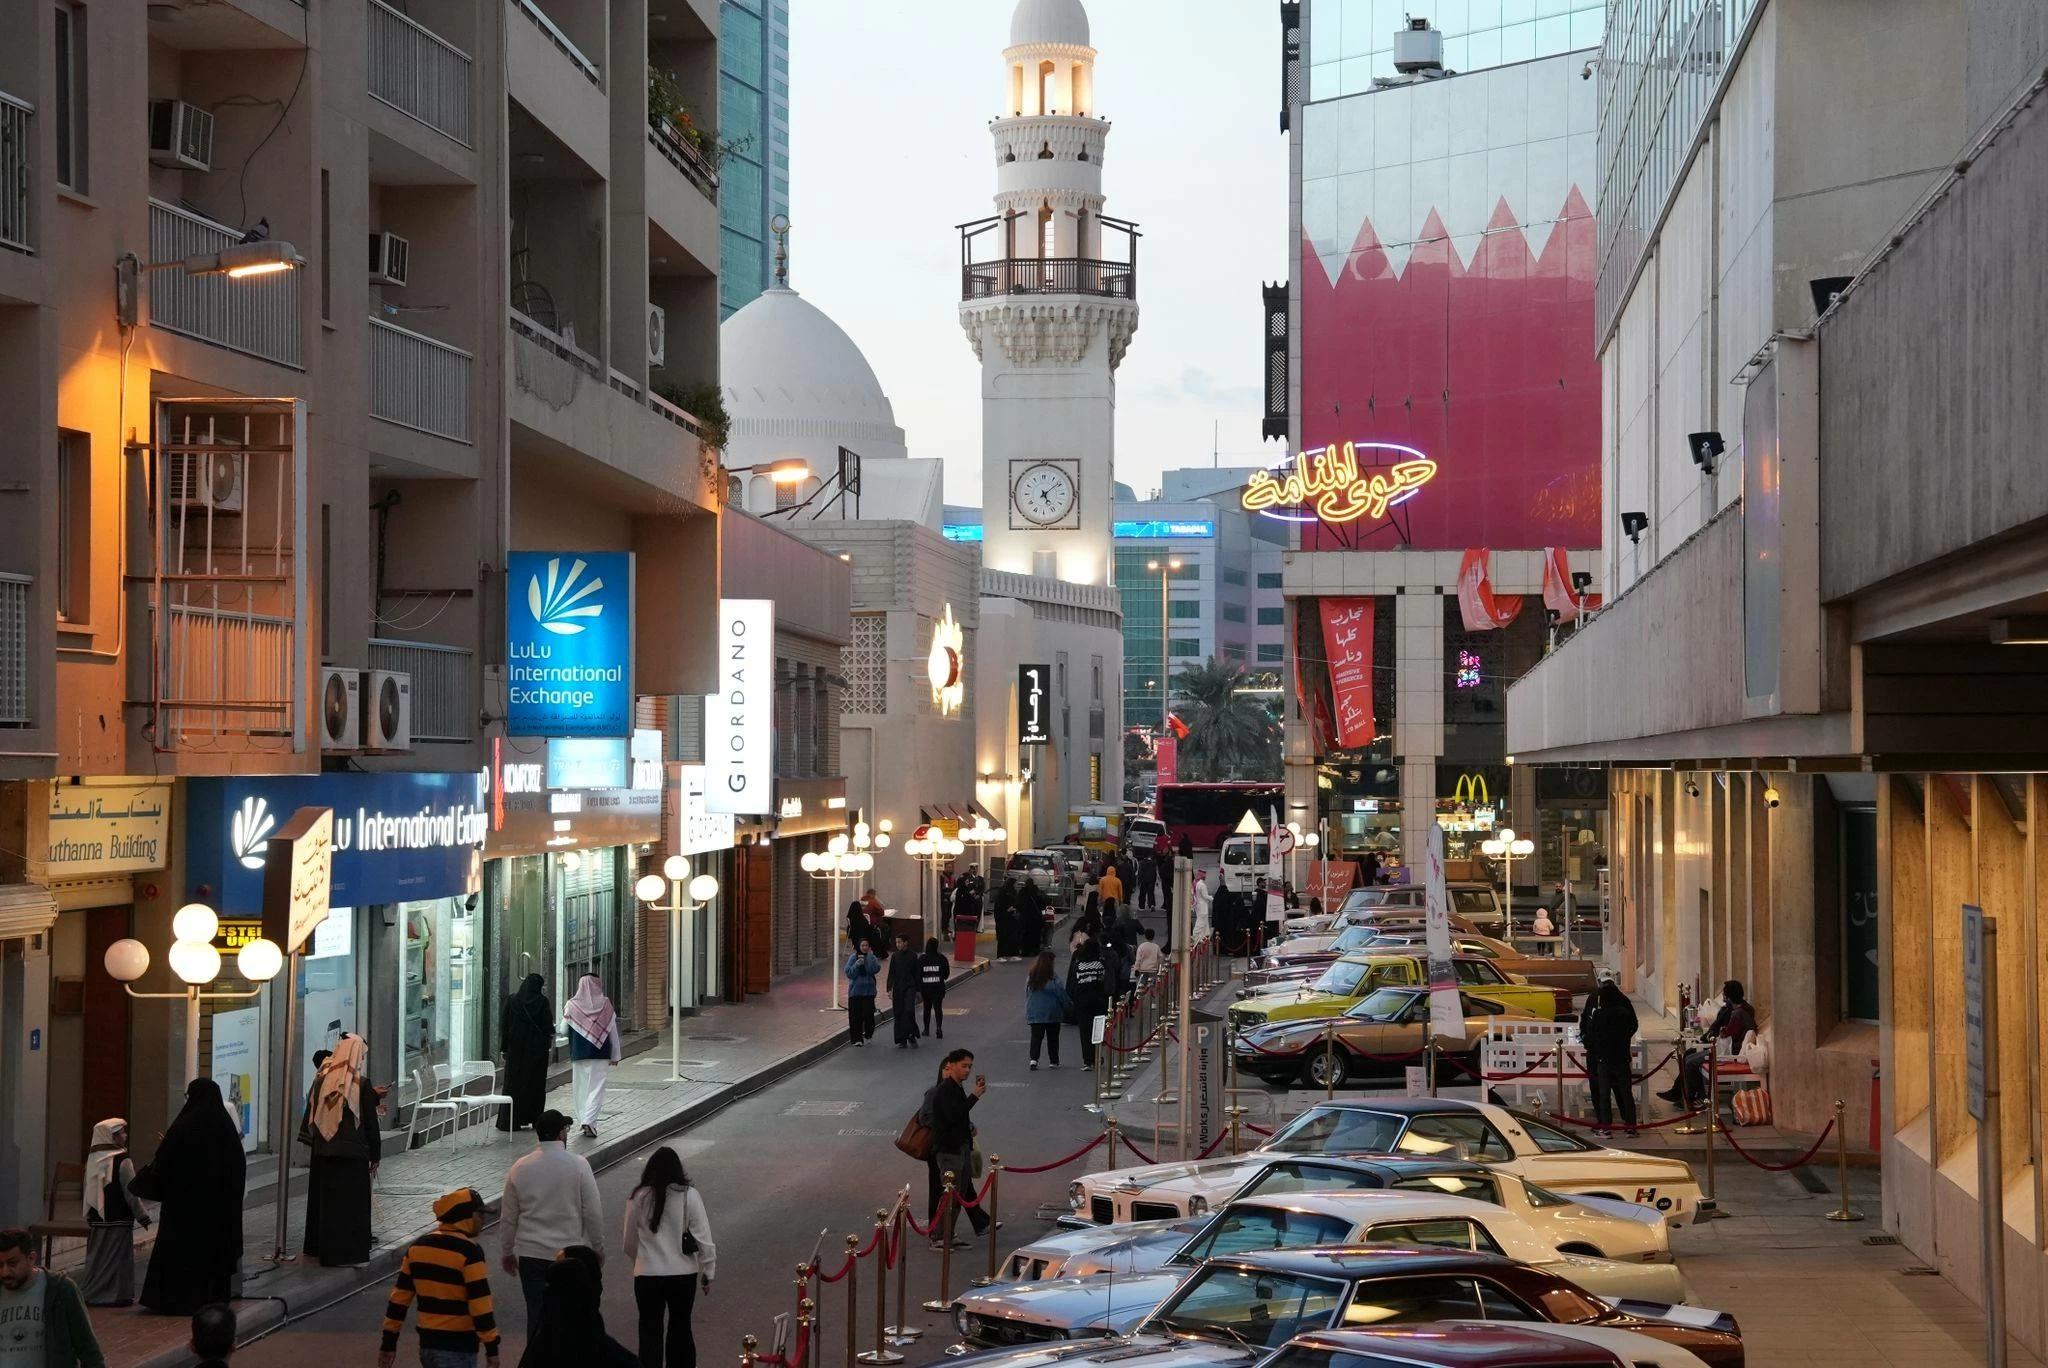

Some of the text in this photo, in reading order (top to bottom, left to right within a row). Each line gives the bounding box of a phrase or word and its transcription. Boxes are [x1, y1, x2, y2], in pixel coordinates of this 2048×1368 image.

[1242, 441, 1359, 510] المنامة
[510, 641, 552, 659] LuLu
[510, 664, 621, 682] International
[510, 687, 594, 708] Exchange
[728, 620, 746, 793] GIORDANO
[96, 798, 162, 824] بناية
[357, 805, 455, 851] International
[49, 834, 157, 863] uthanna Building
[1198, 1026, 1209, 1044] P
